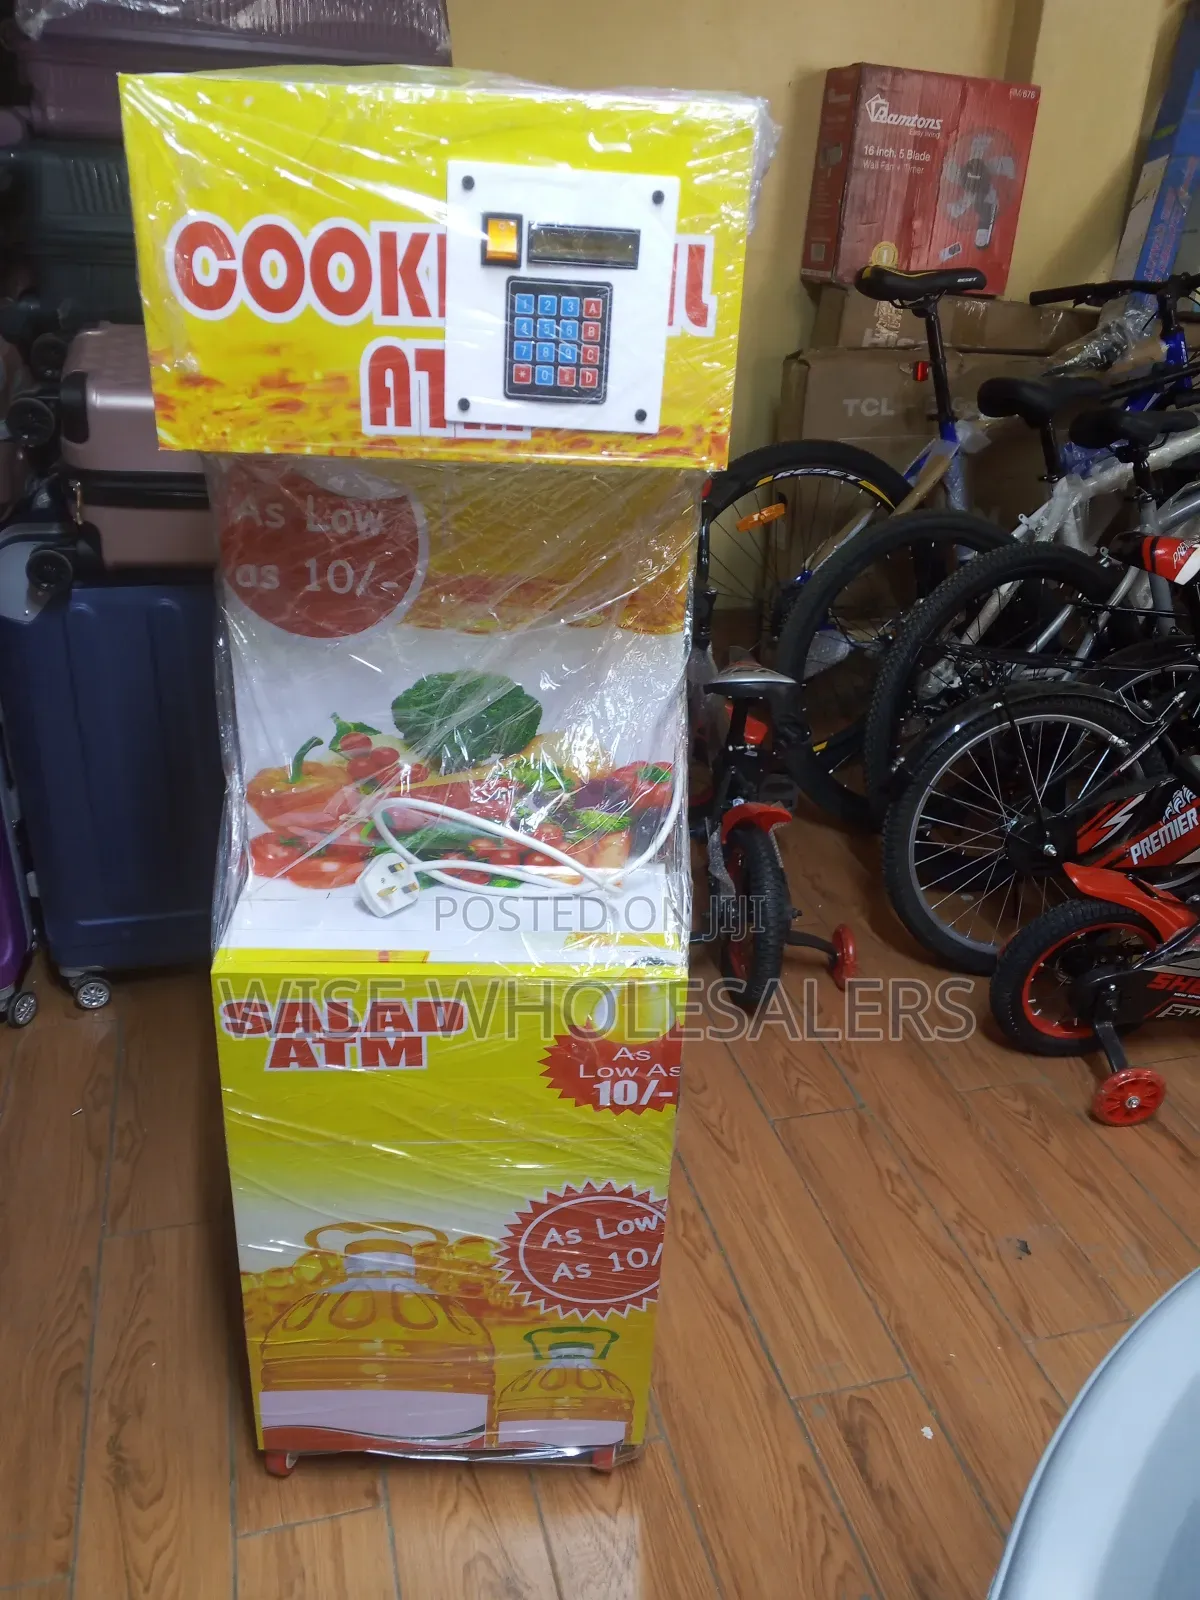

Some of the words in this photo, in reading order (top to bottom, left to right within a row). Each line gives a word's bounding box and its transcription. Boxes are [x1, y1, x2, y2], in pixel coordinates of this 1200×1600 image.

[868, 99, 943, 130] Ramtons
[864, 145, 875, 156] 16
[899, 149, 905, 159] 5
[907, 150, 931, 162] Blade
[863, 159, 879, 169] Wall
[881, 161, 894, 172] Fan
[544, 300, 551, 311] 2
[568, 301, 574, 312] 3
[589, 303, 597, 313] A
[521, 322, 528, 333] 4
[543, 323, 550, 334] 5
[566, 325, 573, 336] 6
[588, 326, 594, 337] B
[521, 345, 527, 356] 7
[543, 347, 549, 358] 8
[587, 350, 594, 360] C
[368, 344, 524, 431] AT
[586, 371, 593, 383] D
[842, 398, 895, 417] TCL
[231, 495, 286, 529] As
[306, 494, 384, 538] Low
[235, 563, 280, 590] as
[304, 558, 399, 597] 10/-
[1130, 807, 1200, 866] PREMIER
[221, 1000, 466, 1036] SALAD
[267, 1036, 425, 1069] ATM
[612, 1046, 652, 1061] As
[579, 1064, 639, 1079] Low
[593, 1079, 673, 1106] 10/-
[541, 1228, 583, 1249] As
[596, 1215, 661, 1240] Low
[552, 1262, 592, 1283] As
